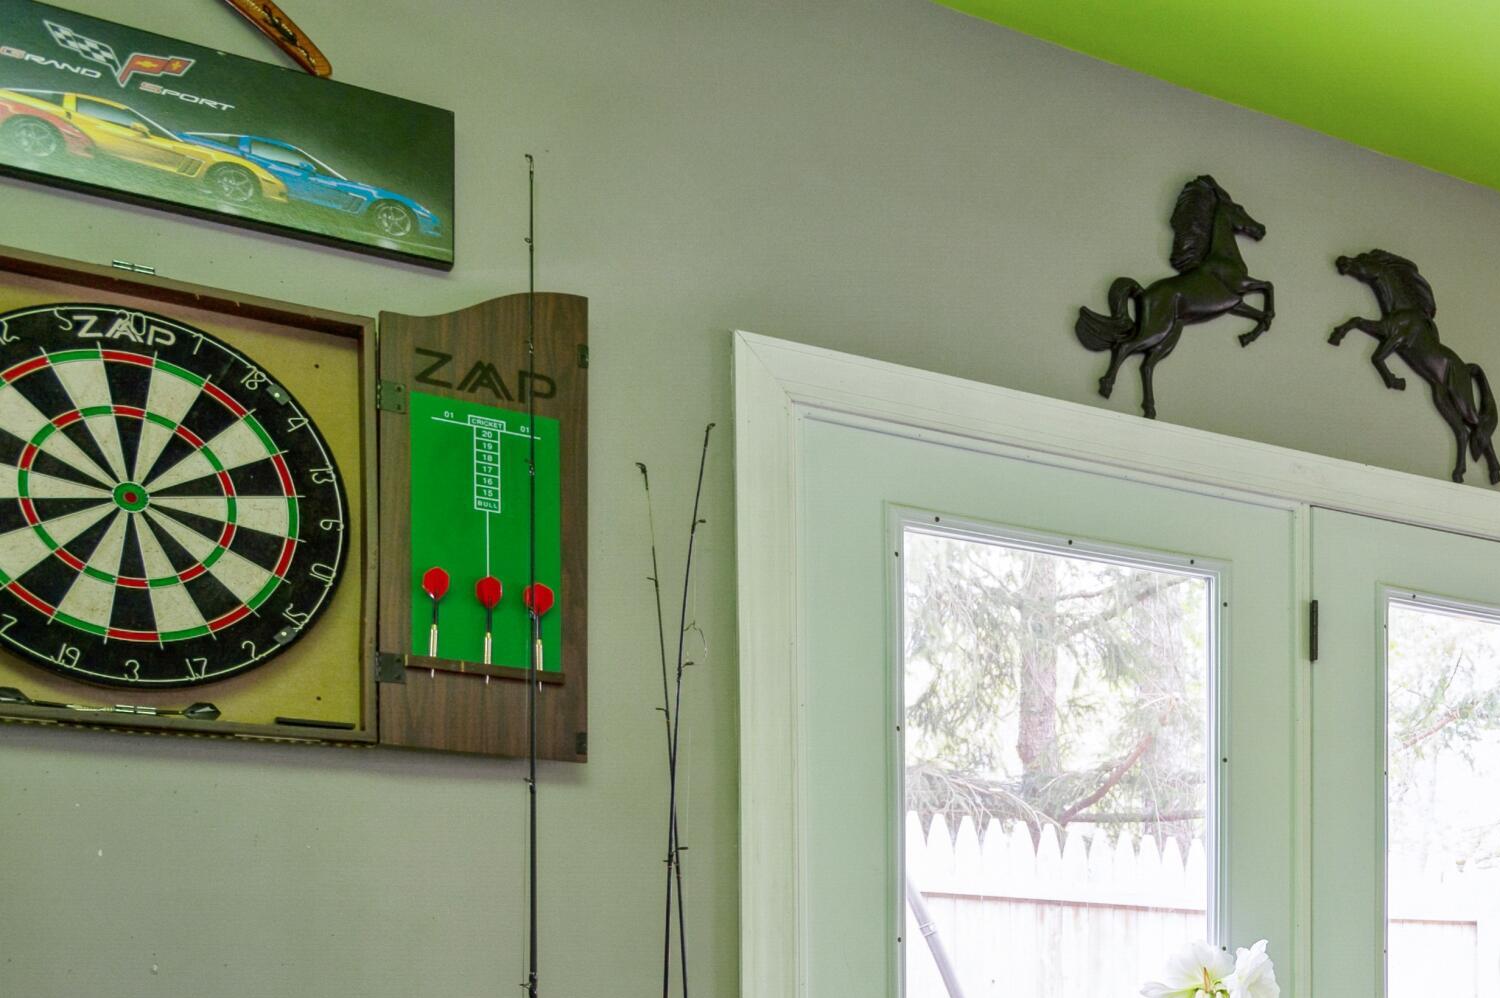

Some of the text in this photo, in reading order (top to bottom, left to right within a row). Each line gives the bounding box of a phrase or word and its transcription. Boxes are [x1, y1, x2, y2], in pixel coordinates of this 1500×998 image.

[0, 45, 235, 112] GRAND SPORT
[72, 315, 176, 347] ZAP
[414, 346, 558, 404] ZAP
[470, 417, 504, 430] CRICKET
[481, 430, 493, 438] 20
[482, 442, 493, 450] 19
[482, 454, 493, 462] 18
[482, 477, 493, 485] 16
[482, 489, 493, 497] 15
[477, 500, 498, 509] BULL
[123, 659, 141, 682] 3
